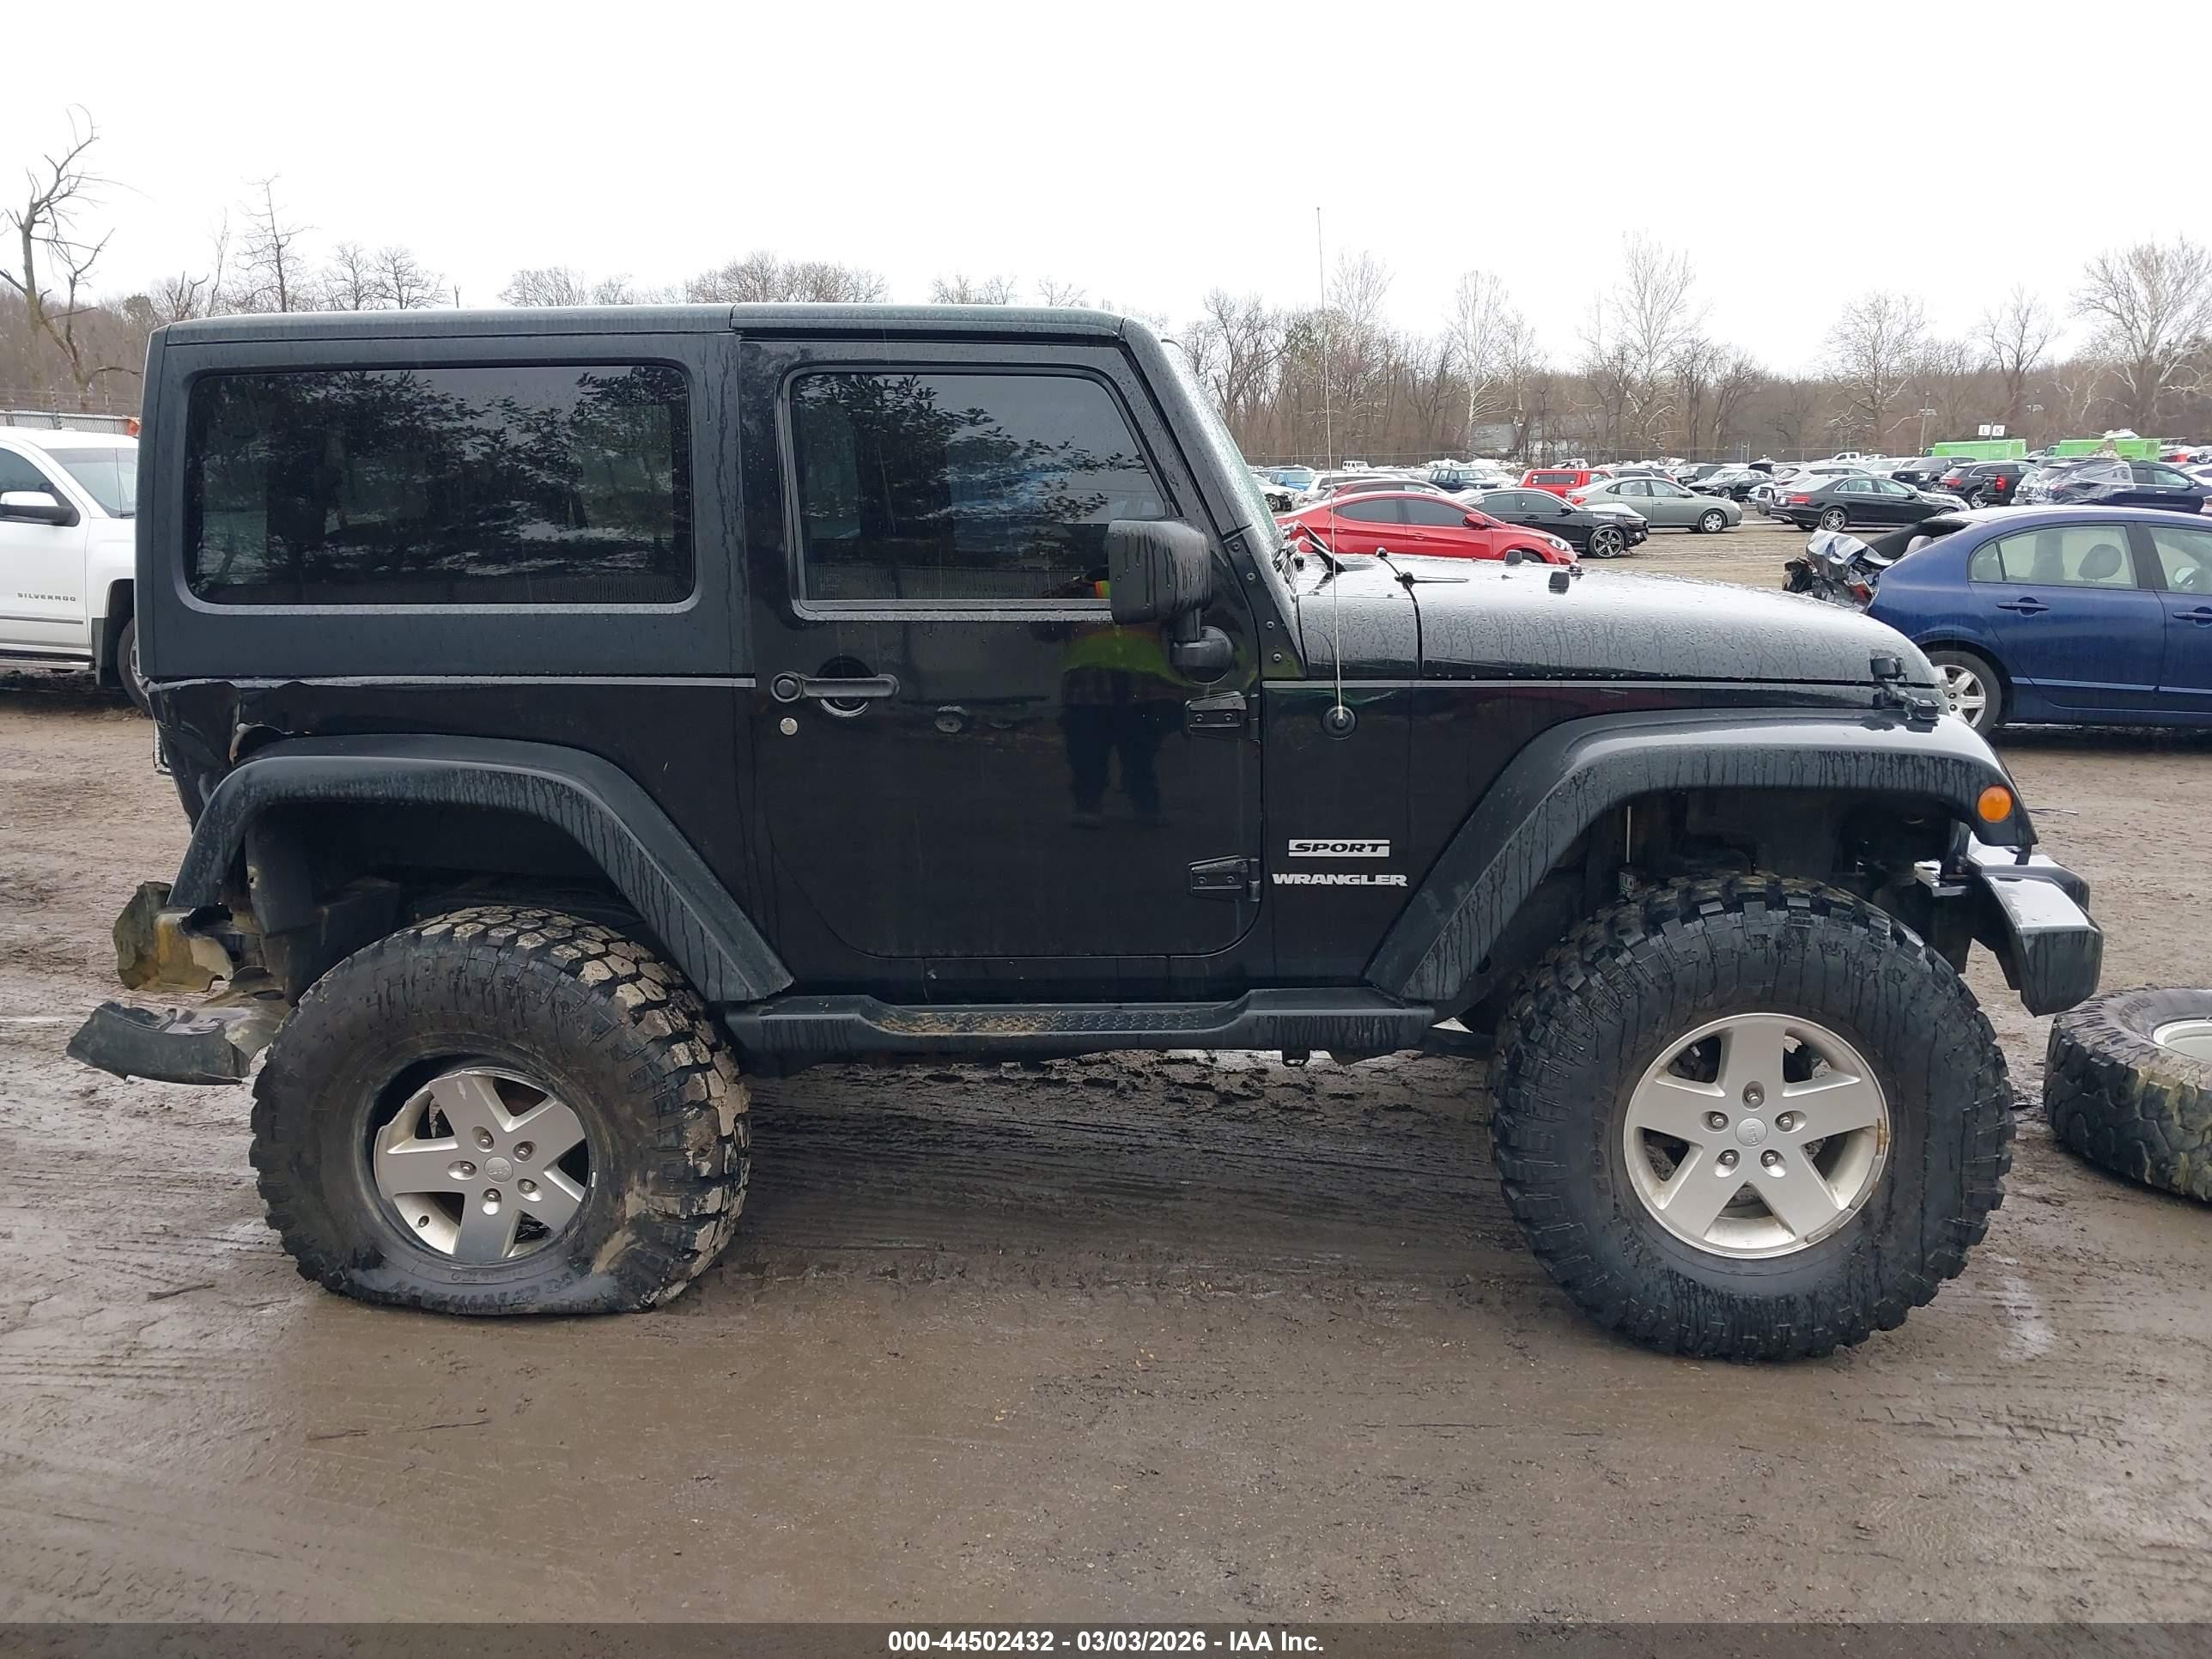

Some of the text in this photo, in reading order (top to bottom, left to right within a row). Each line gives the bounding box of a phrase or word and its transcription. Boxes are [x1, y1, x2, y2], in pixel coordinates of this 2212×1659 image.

[17, 592, 76, 602] SILVERADO
[1291, 842, 1389, 854] SPORT
[1272, 873, 1408, 887] WRANGLER
